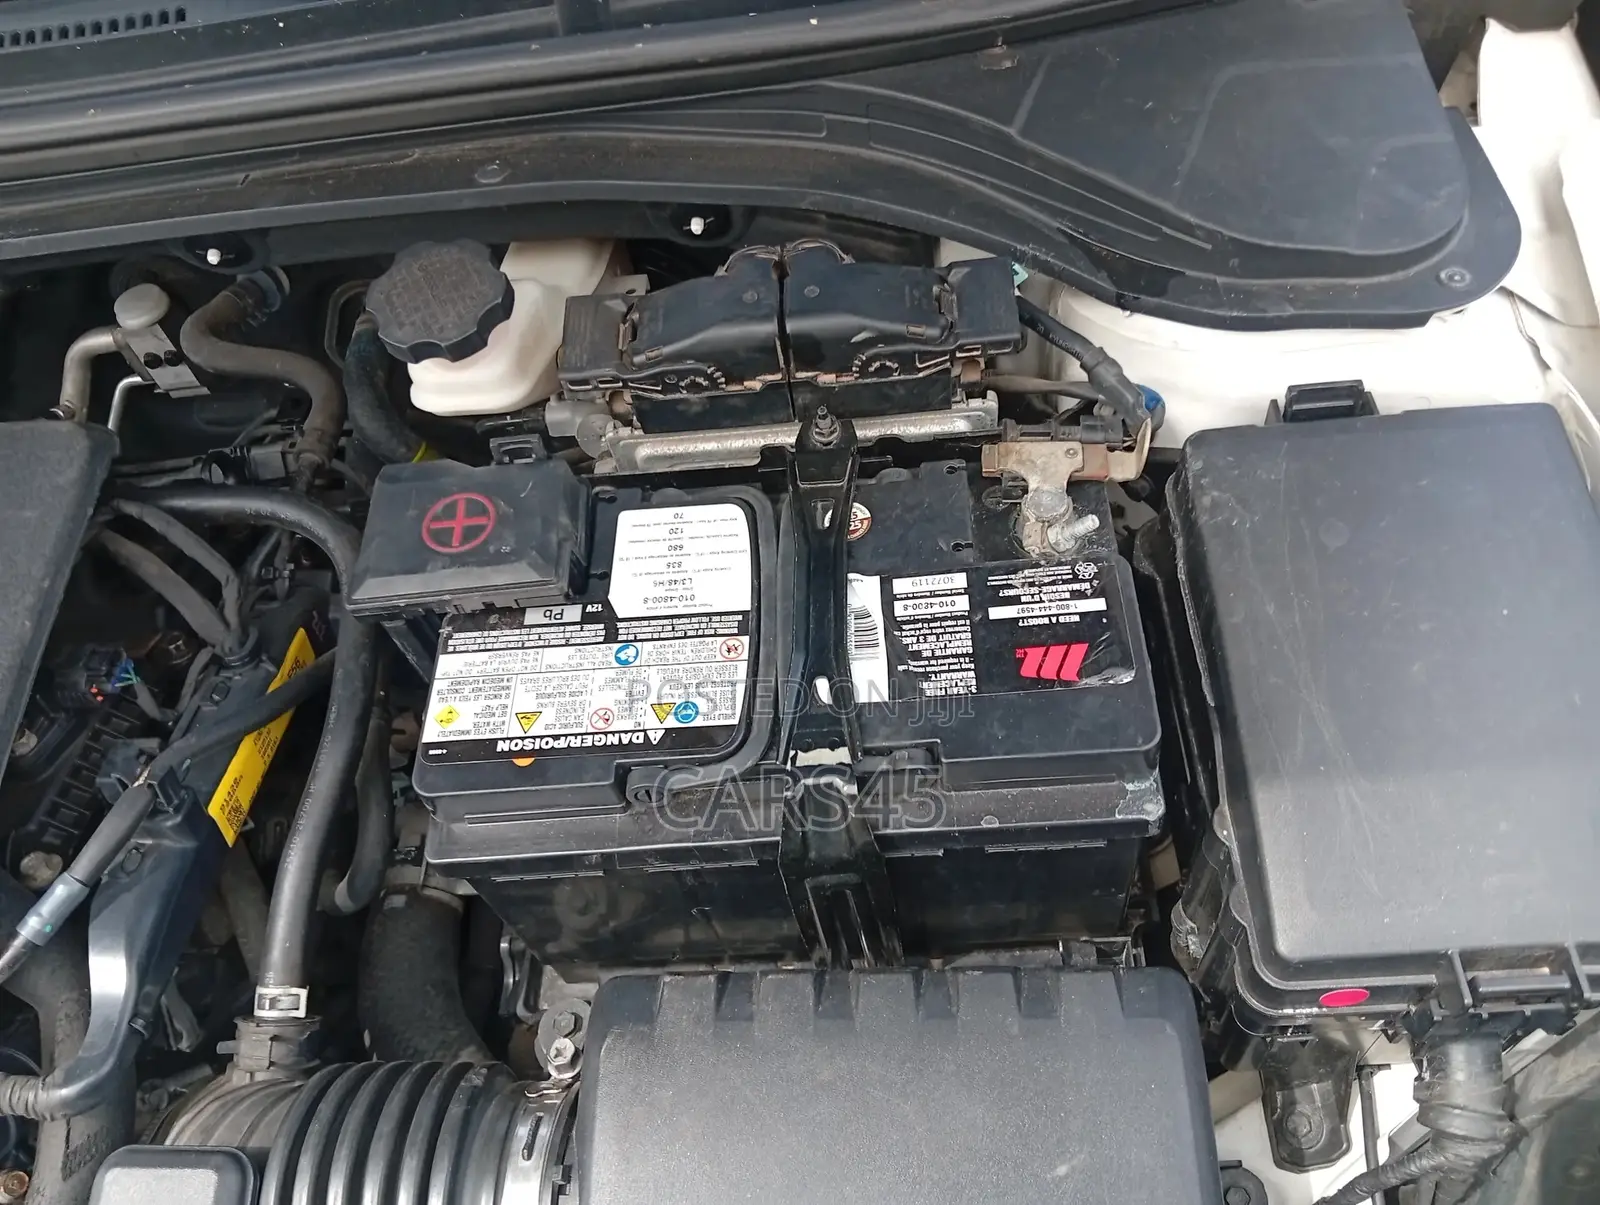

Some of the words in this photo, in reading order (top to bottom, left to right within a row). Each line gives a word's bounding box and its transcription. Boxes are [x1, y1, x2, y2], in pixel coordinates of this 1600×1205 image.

[667, 544, 684, 552] 680
[666, 561, 682, 569] 835
[912, 576, 955, 587] 3072119
[586, 604, 603, 612] 12V
[903, 600, 956, 611] 010-4800-8
[1017, 603, 1077, 614] 1-800-444-4597
[543, 609, 564, 620] Pb
[1058, 615, 1080, 623] NEED
[1018, 617, 1049, 626] BOOST?
[899, 636, 917, 644] ANS.
[938, 632, 971, 641] GRATUIT
[908, 639, 972, 651] REMPLACEMENT
[933, 647, 973, 656] GARANTIE
[929, 671, 976, 680] WARRANTY.
[919, 679, 976, 688] REPLACEMENT
[925, 688, 945, 696] FREE
[947, 685, 977, 694] 3-YEAR
[496, 732, 644, 752] DANGER/POISON
